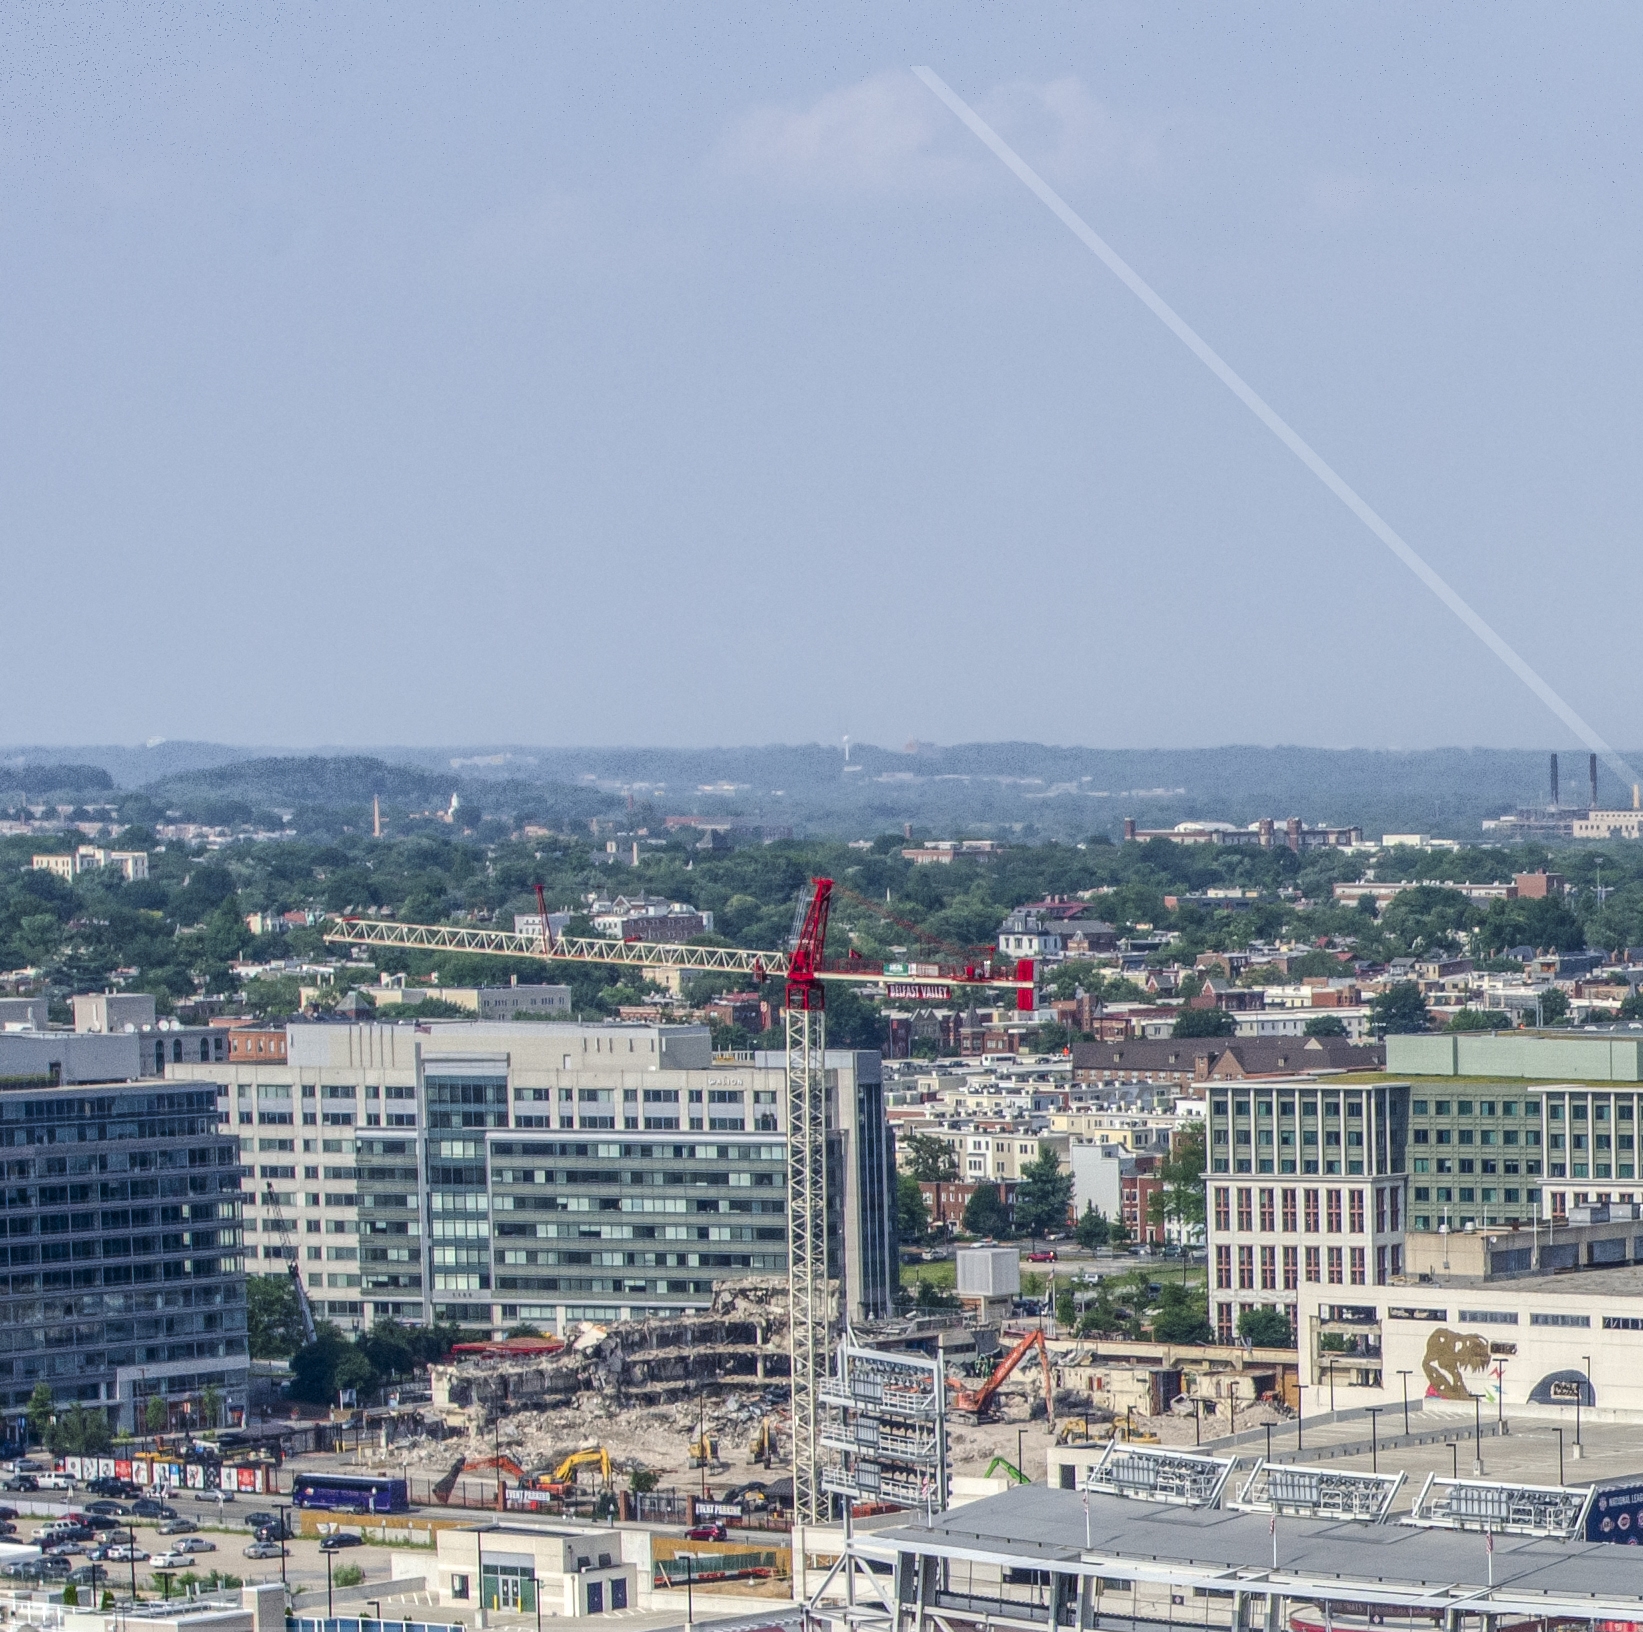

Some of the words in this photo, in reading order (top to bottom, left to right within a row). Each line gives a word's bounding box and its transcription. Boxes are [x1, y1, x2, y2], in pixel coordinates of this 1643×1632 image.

[889, 985, 919, 998] BELFAST
[920, 985, 948, 998] VALLEY
[1608, 1494, 1630, 1506] NATIONAL
